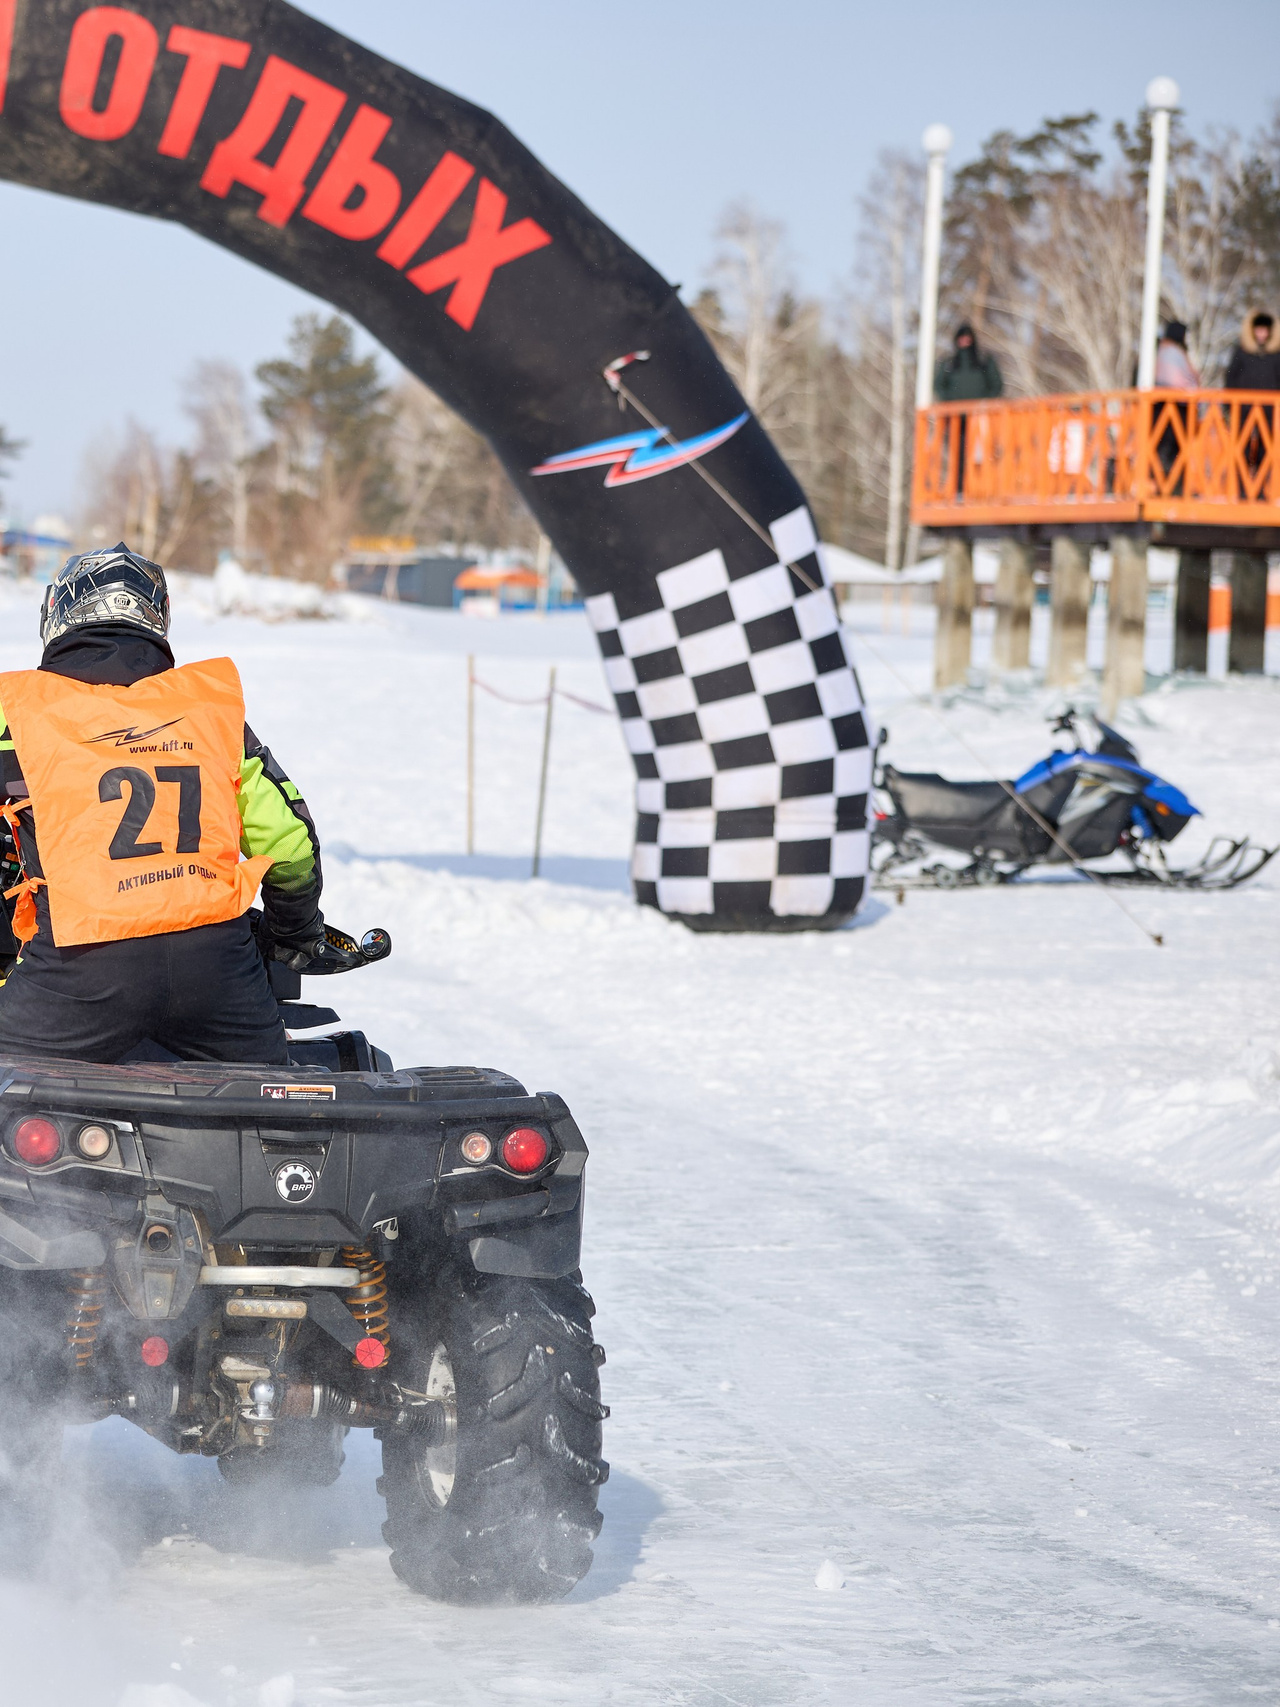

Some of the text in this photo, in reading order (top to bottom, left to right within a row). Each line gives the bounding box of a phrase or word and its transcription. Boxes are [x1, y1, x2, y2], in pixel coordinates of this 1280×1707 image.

[58, 5, 553, 333] ОТДЫХ
[129, 739, 193, 754] www.hft.ru
[98, 765, 202, 861] 27
[117, 863, 184, 893] АКТИВНЫЙ
[291, 1183, 312, 1191] BRP
